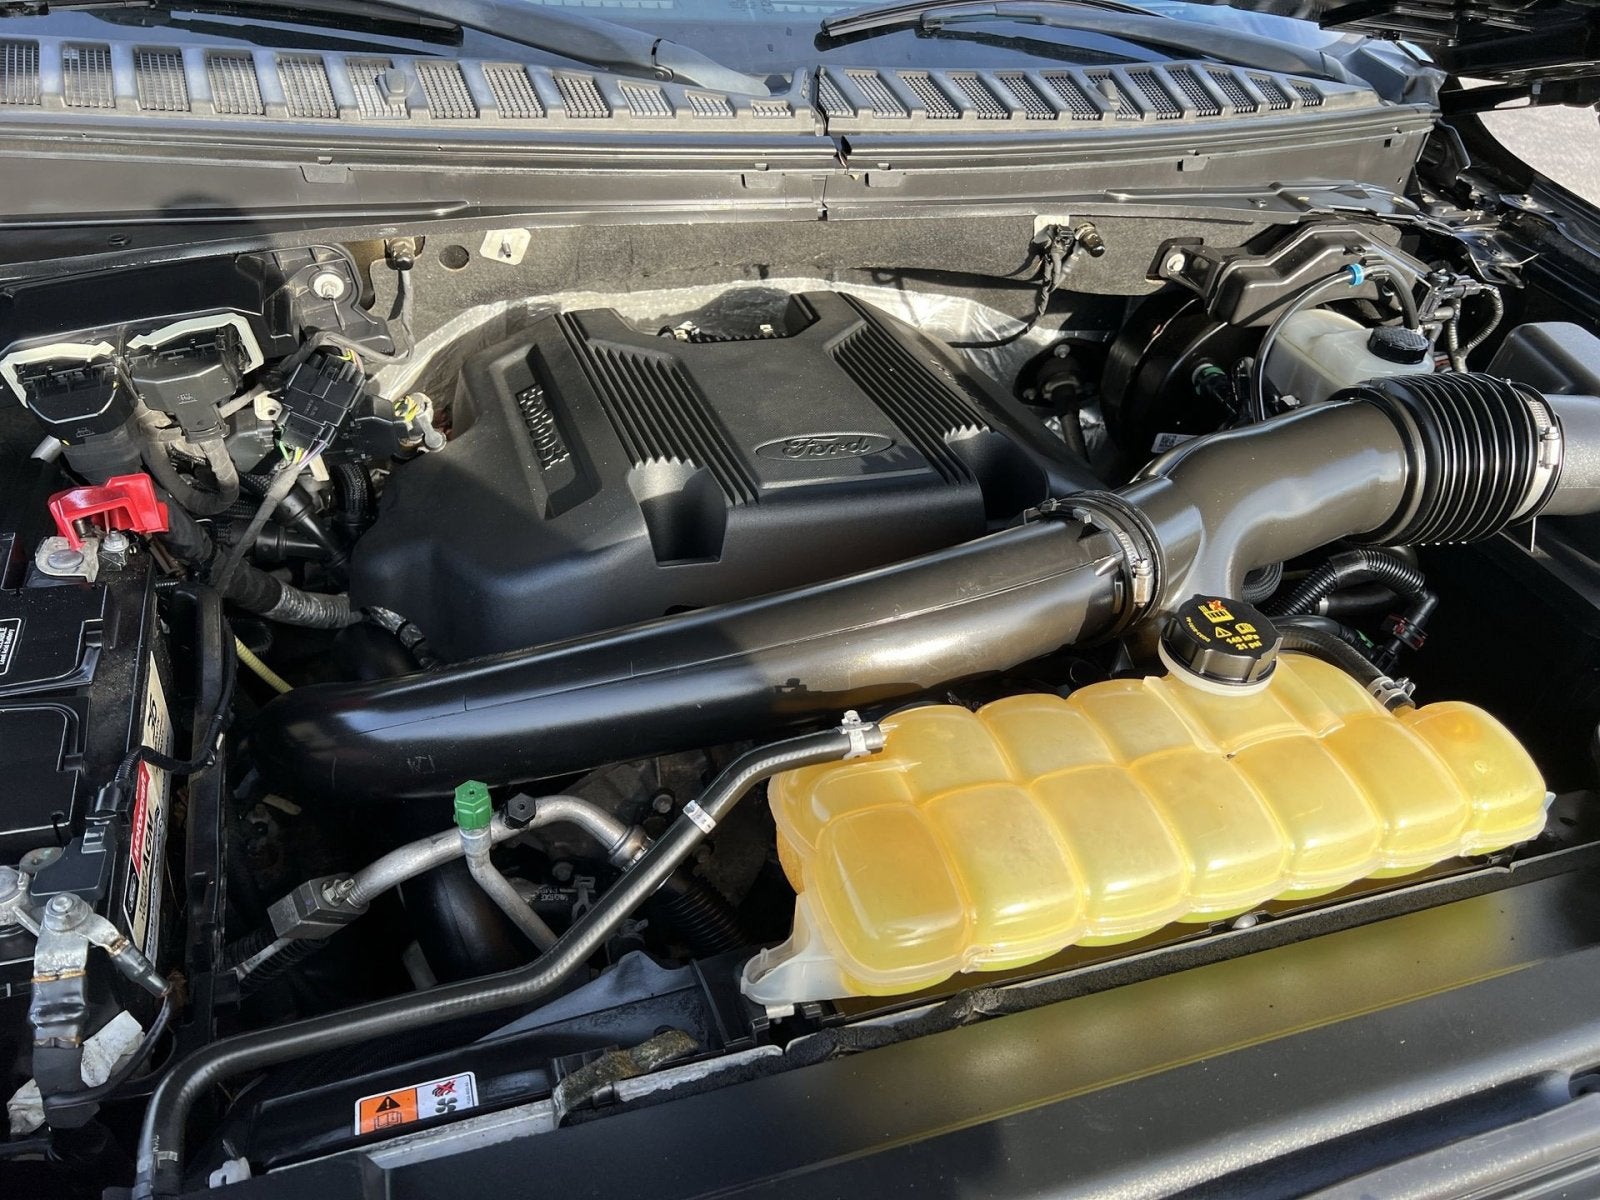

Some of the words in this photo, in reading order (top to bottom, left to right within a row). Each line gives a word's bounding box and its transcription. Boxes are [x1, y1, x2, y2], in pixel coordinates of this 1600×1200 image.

[783, 437, 870, 458] Ford
[134, 771, 147, 861] Motorcraft
[143, 811, 153, 868] AGM
